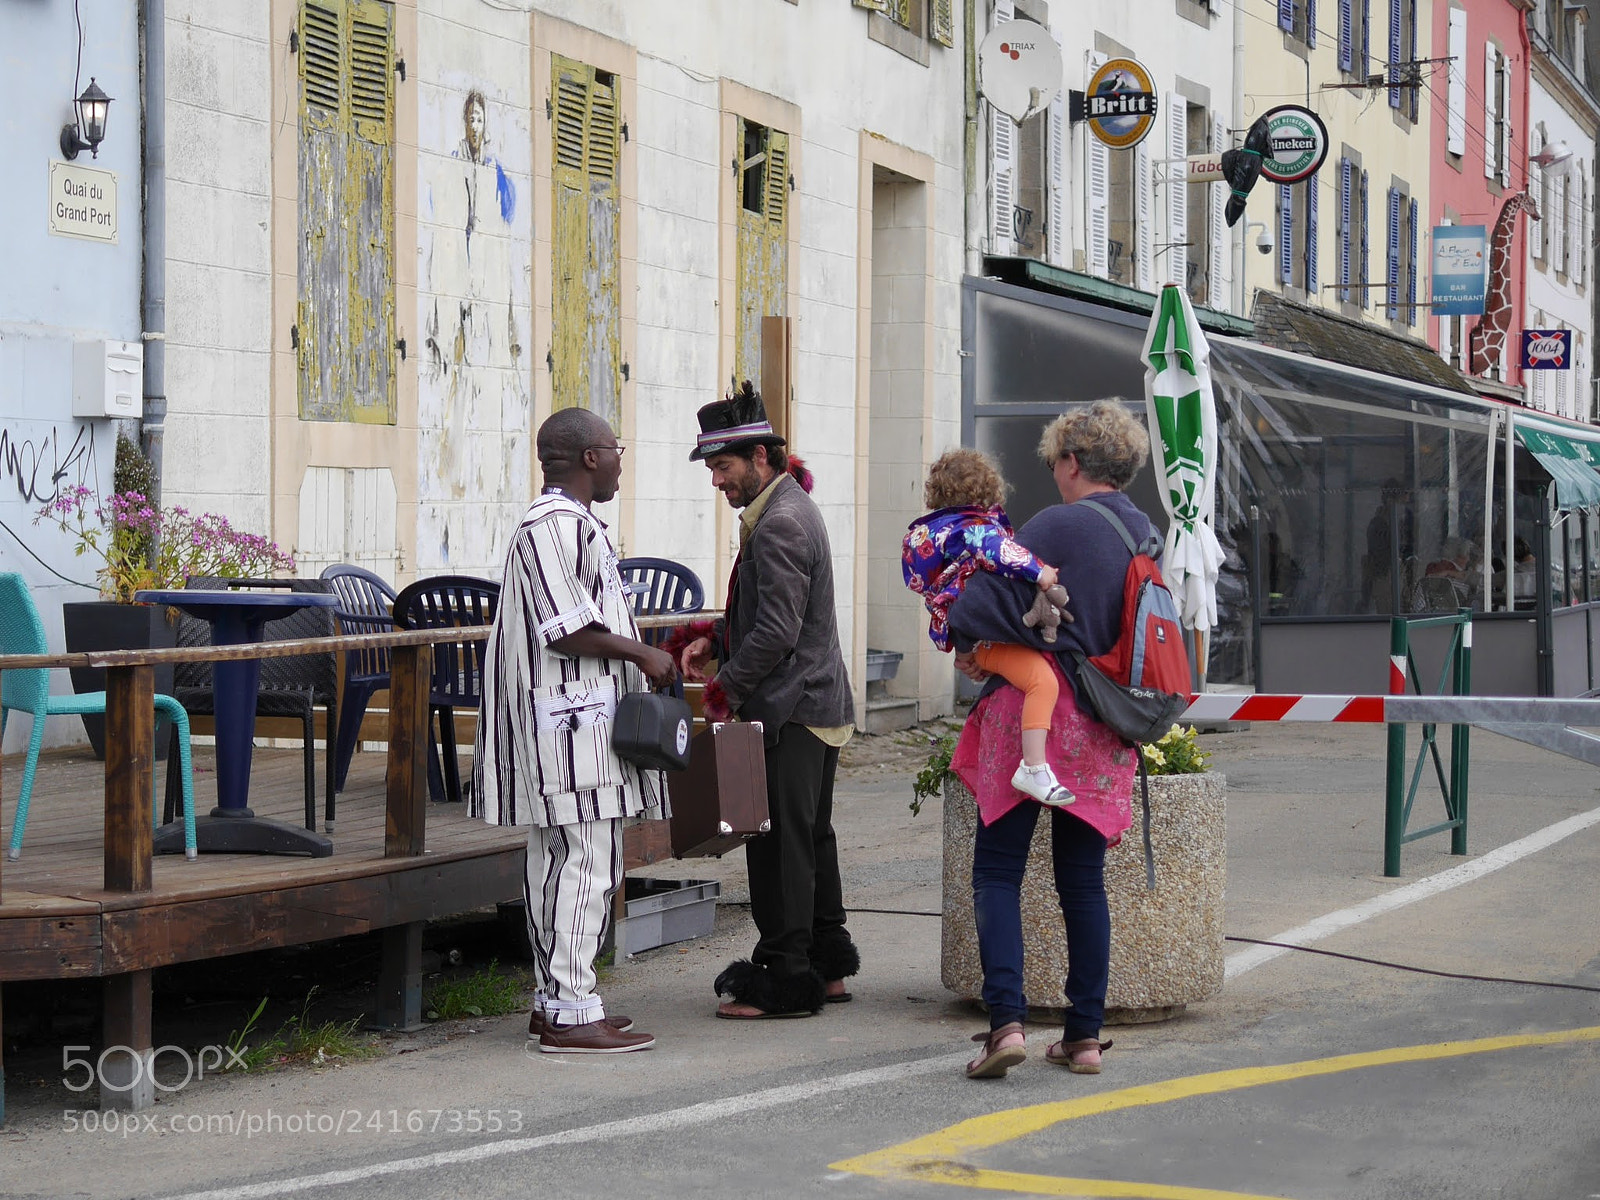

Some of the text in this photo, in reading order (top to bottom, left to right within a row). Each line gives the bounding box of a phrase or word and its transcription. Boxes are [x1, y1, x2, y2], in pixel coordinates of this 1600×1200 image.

[1010, 42, 1035, 50] TRIAX
[1091, 95, 1148, 115] Britt
[1272, 139, 1313, 149] ineken
[64, 178, 103, 200] Quai du
[56, 202, 111, 226] Grand Port
[1449, 245, 1470, 254] Fleur
[1433, 294, 1484, 302] RESTAURANT
[1531, 340, 1560, 354] 1664
